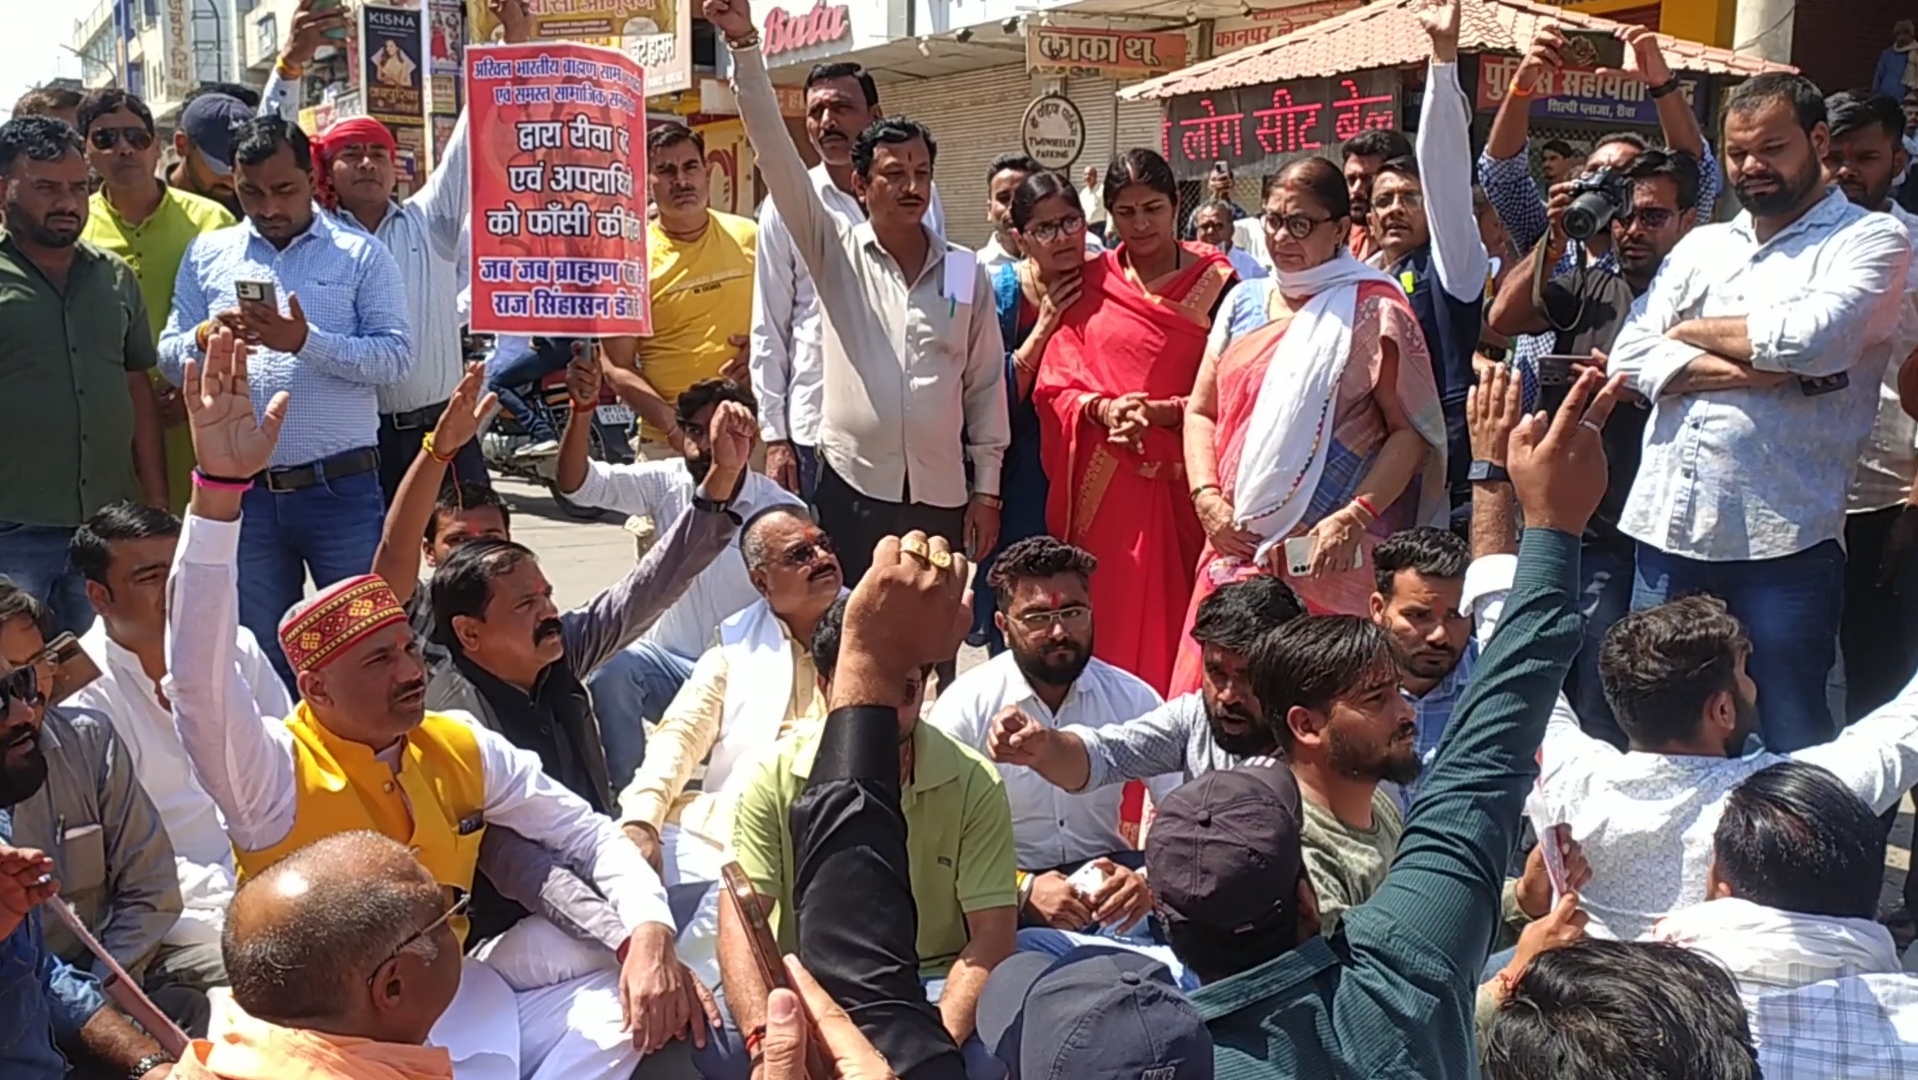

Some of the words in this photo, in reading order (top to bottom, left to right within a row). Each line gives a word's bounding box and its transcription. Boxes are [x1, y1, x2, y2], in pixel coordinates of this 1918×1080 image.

[368, 12, 416, 28] KISNA
[761, 2, 849, 56] Bata
[1039, 31, 1119, 64] काका
[1214, 25, 1274, 47] कानपुर
[474, 56, 512, 78] अखिल
[516, 54, 559, 77] भारतीय
[494, 83, 512, 104] एवं
[515, 86, 551, 104] समस्त
[554, 82, 607, 105] सामाजिक
[1562, 68, 1646, 102] सहायता
[516, 121, 564, 151] द्वारा
[568, 114, 613, 152] रीवा
[1180, 99, 1245, 161] लोग
[1253, 88, 1323, 153] सीट
[1035, 149, 1070, 159] PARKING
[508, 161, 546, 192] एवं
[486, 202, 521, 236] को
[526, 202, 591, 236] फाँसी
[479, 258, 513, 281] जब
[516, 258, 552, 281] जब
[493, 293, 530, 315] राज
[532, 288, 610, 317] सिंहासन
